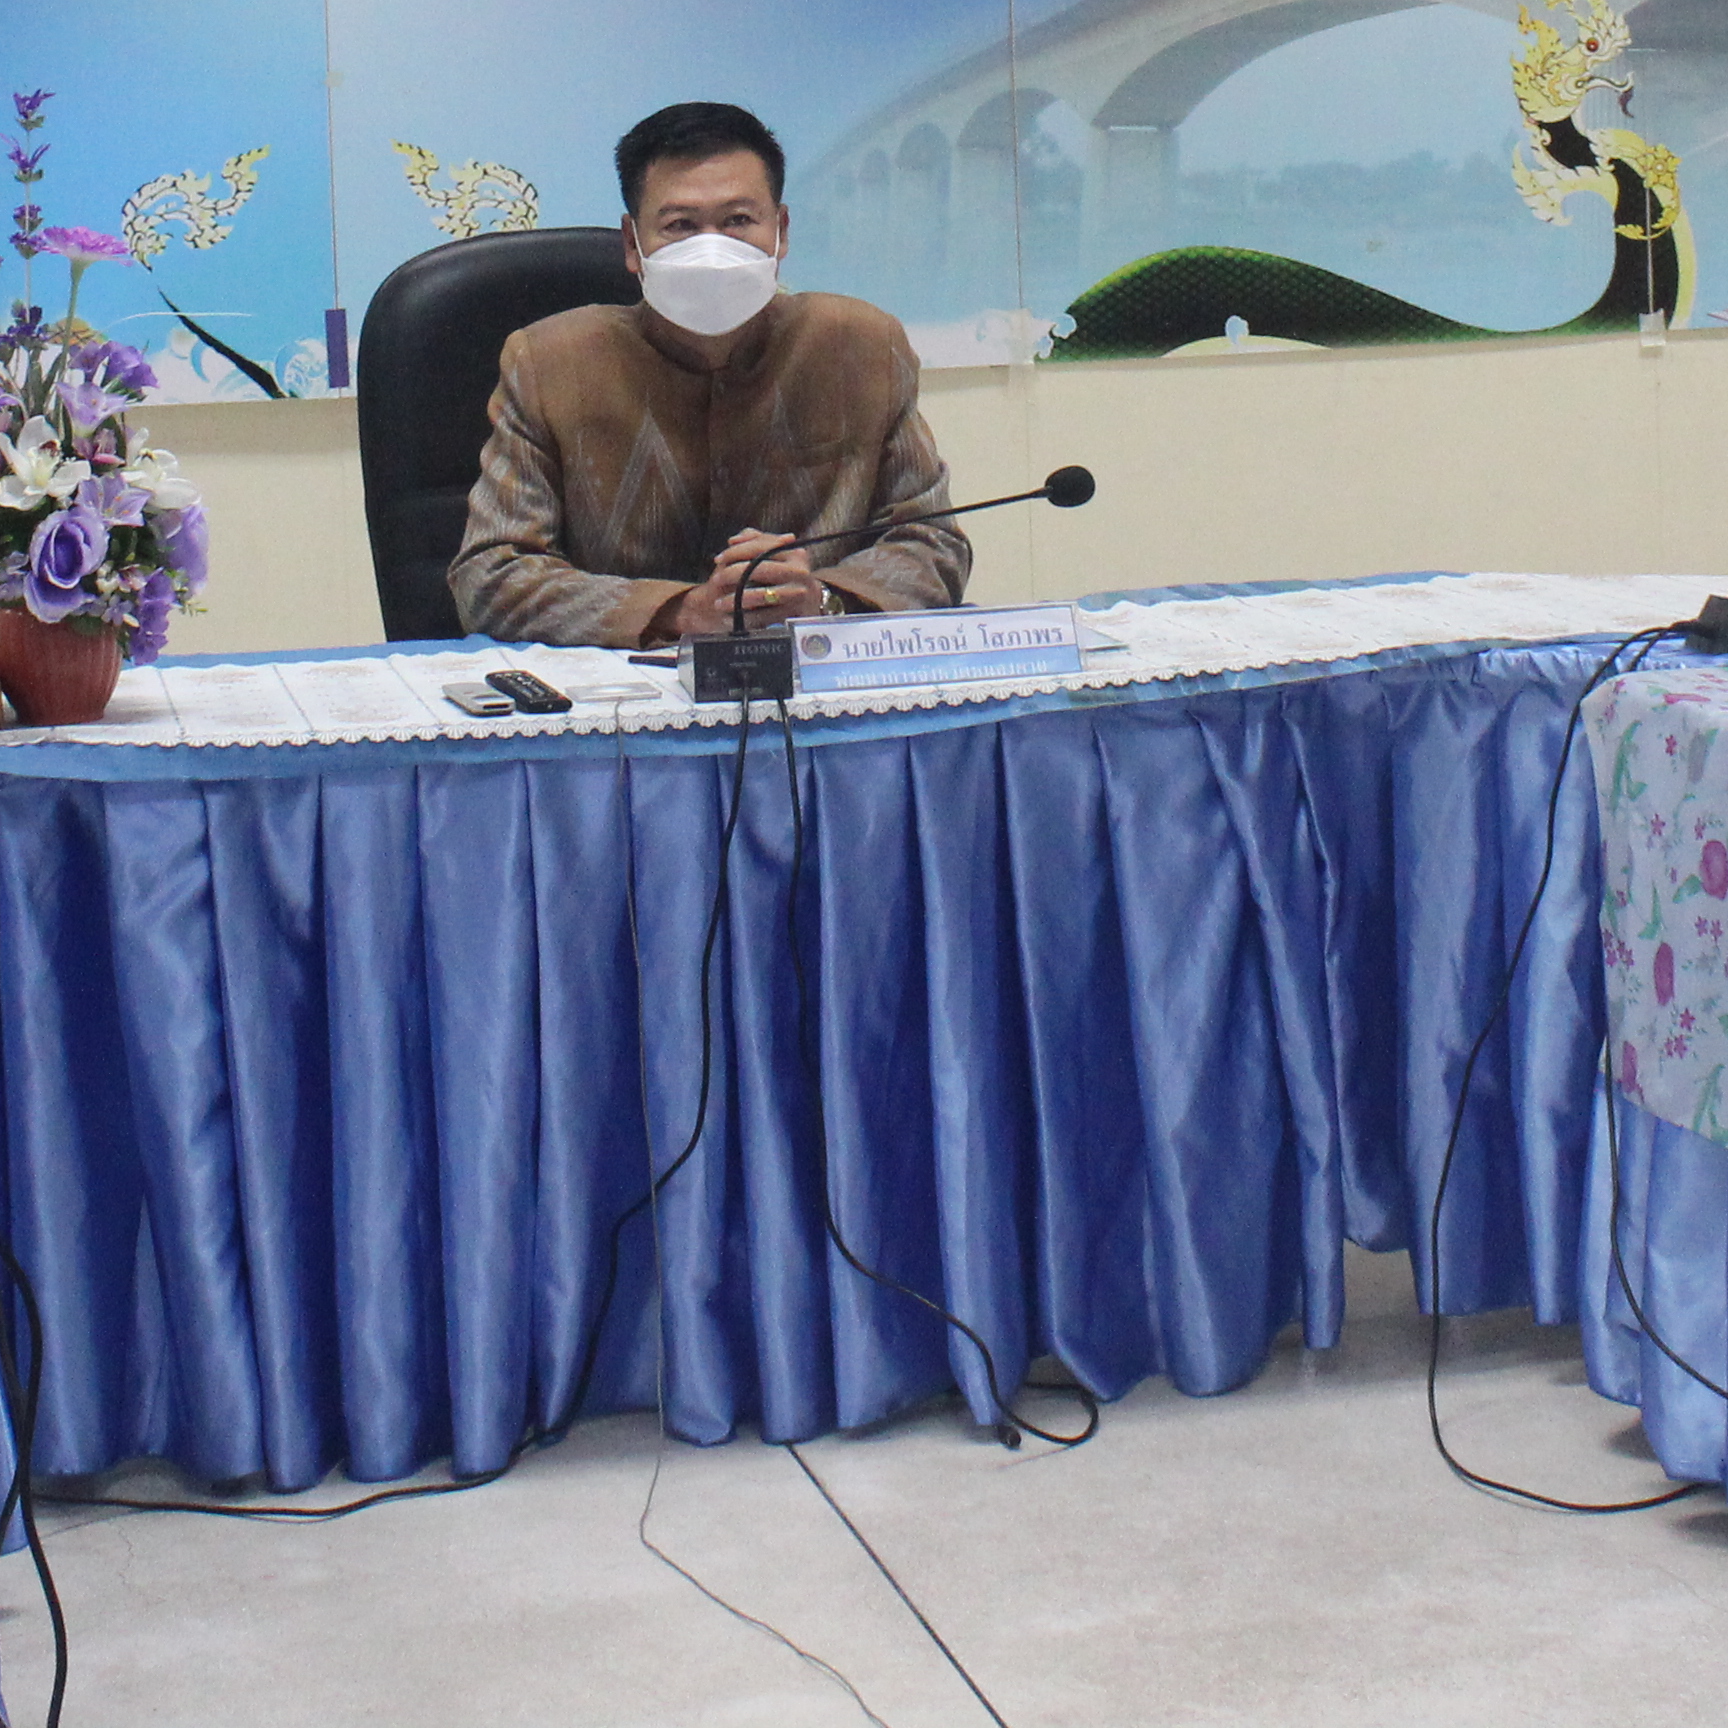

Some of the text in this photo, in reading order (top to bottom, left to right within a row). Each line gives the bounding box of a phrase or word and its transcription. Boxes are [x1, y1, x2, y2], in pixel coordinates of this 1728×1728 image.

[842, 624, 1064, 658] นายไพโรจน์ โสภาพร
